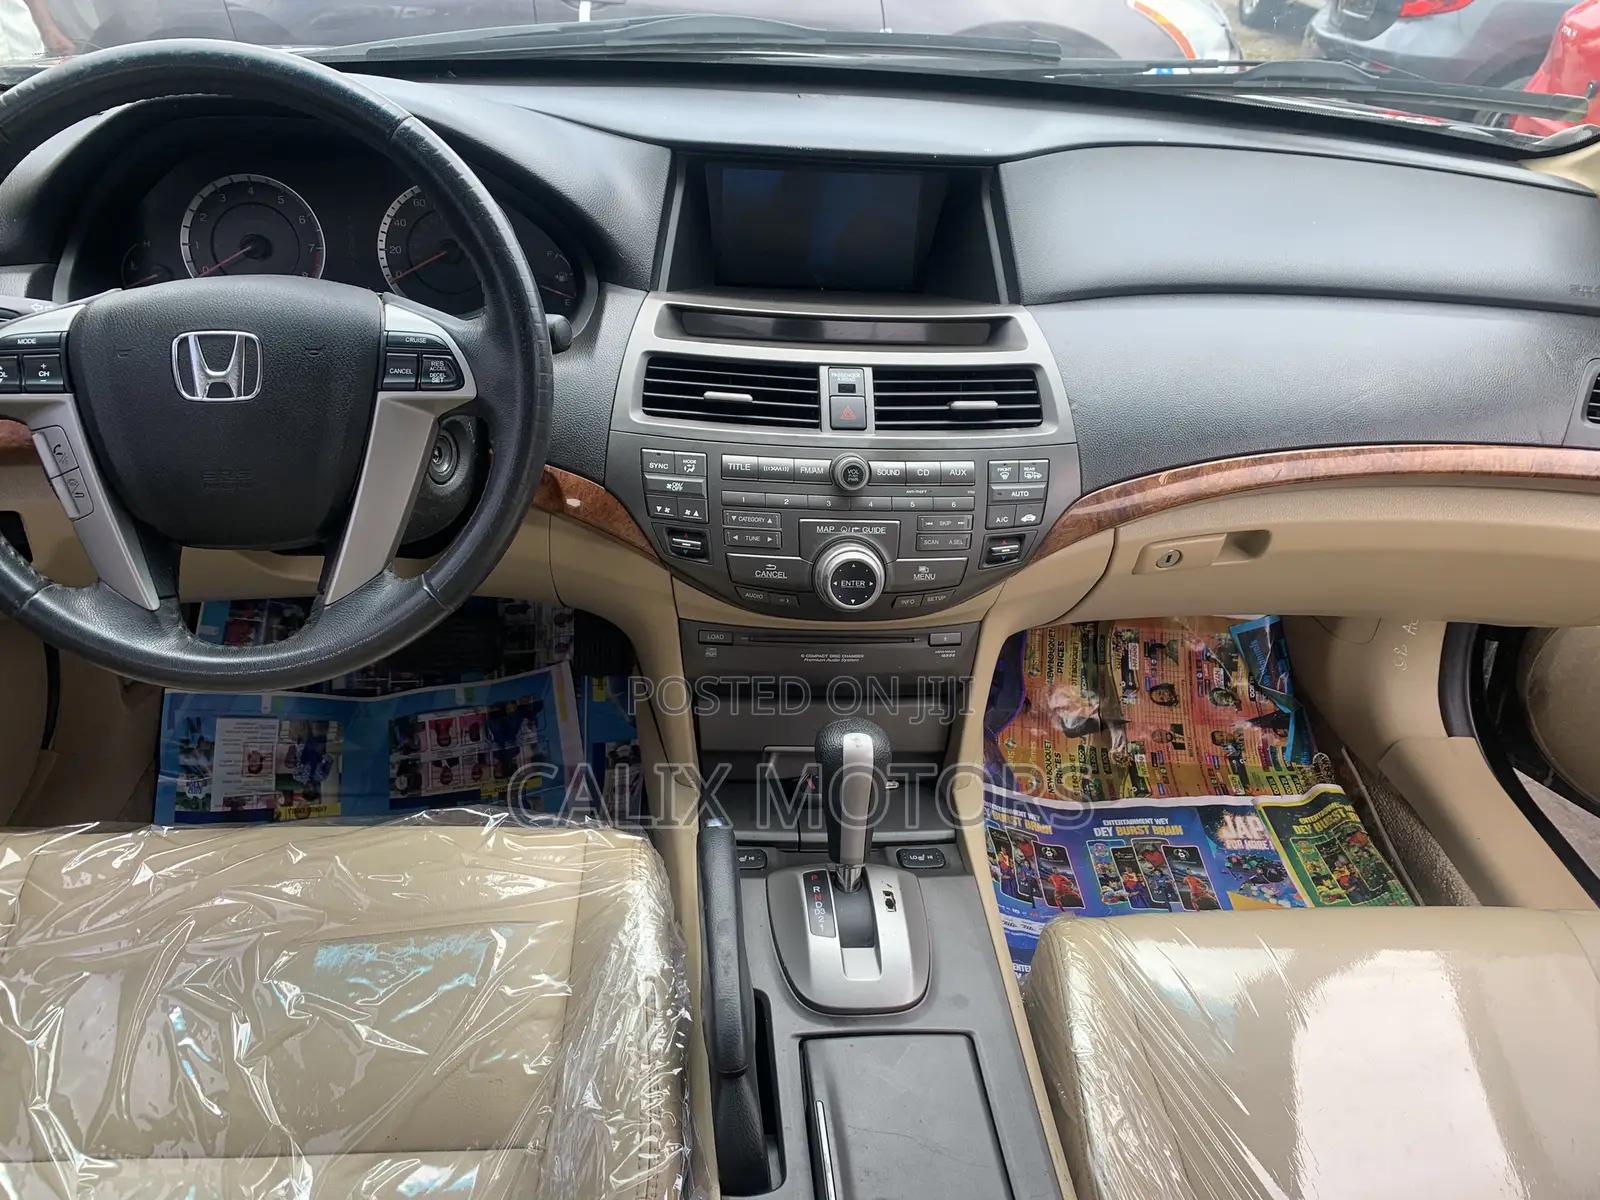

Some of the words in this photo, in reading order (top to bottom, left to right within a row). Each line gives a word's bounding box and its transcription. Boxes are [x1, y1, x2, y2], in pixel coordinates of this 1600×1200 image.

[247, 186, 254, 195] 4
[219, 194, 226, 203] 3
[277, 195, 284, 205] 5
[200, 213, 207, 222] 2
[299, 215, 306, 224] 6
[308, 243, 315, 253] 7
[389, 245, 402, 254] 20
[17, 337, 37, 345] MODE
[404, 336, 427, 344] CRUISE
[389, 367, 413, 375] CANCEL
[649, 462, 669, 470] SYNC
[728, 462, 751, 471] TITLE
[800, 466, 824, 474] FM/AM
[876, 468, 900, 476] SOUND
[949, 468, 967, 476] AUX
[738, 515, 766, 523] CATEGORY
[816, 525, 835, 533] MAP
[862, 526, 886, 534] GUIDE
[924, 538, 939, 546] SCAN
[754, 570, 787, 579] CANCEL
[745, 592, 764, 600] AUDIO
[1056, 640, 1065, 674] PRICES
[1044, 740, 1054, 776] BOUQUET
[1054, 752, 1064, 785] PRICES
[1045, 775, 1055, 794] NEW
[1102, 817, 1153, 825] ENTERTAINMENT
[1154, 817, 1169, 825] WEY
[1292, 824, 1312, 834] DEY
[1312, 808, 1347, 832] BURST
[1093, 827, 1114, 838] DEY
[1115, 825, 1150, 836] BURST
[1152, 824, 1184, 836] BRAIN
[1226, 839, 1243, 850] FOR
[1245, 839, 1269, 850] MORE
[812, 885, 821, 893] R
[814, 893, 822, 901] N
[815, 901, 823, 909] D
[818, 915, 825, 923] 2
